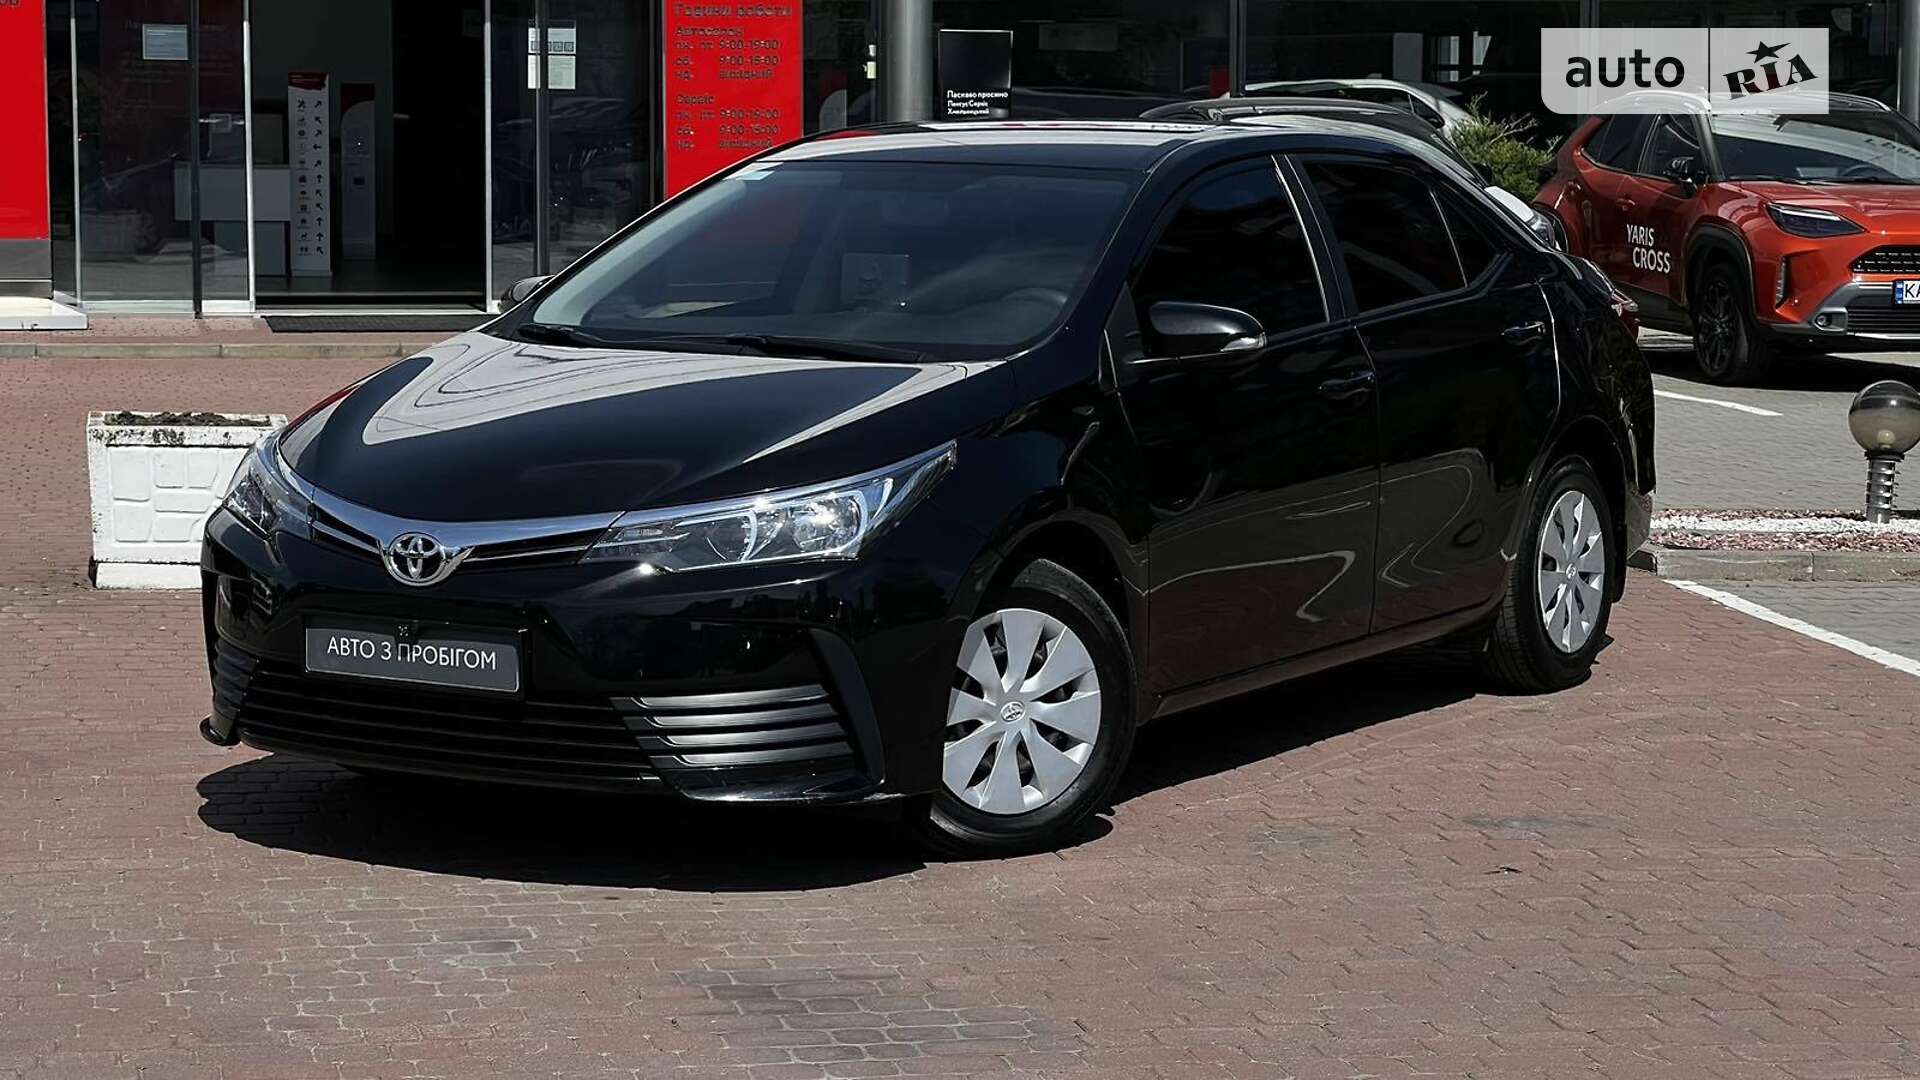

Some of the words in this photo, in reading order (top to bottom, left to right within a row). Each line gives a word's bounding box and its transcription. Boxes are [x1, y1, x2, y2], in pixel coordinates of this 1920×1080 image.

[1626, 223, 1655, 247] YARIS
[1632, 246, 1671, 274] CROSS
[327, 635, 376, 659] АВТО
[397, 642, 497, 671] ПРОБІГОМ
